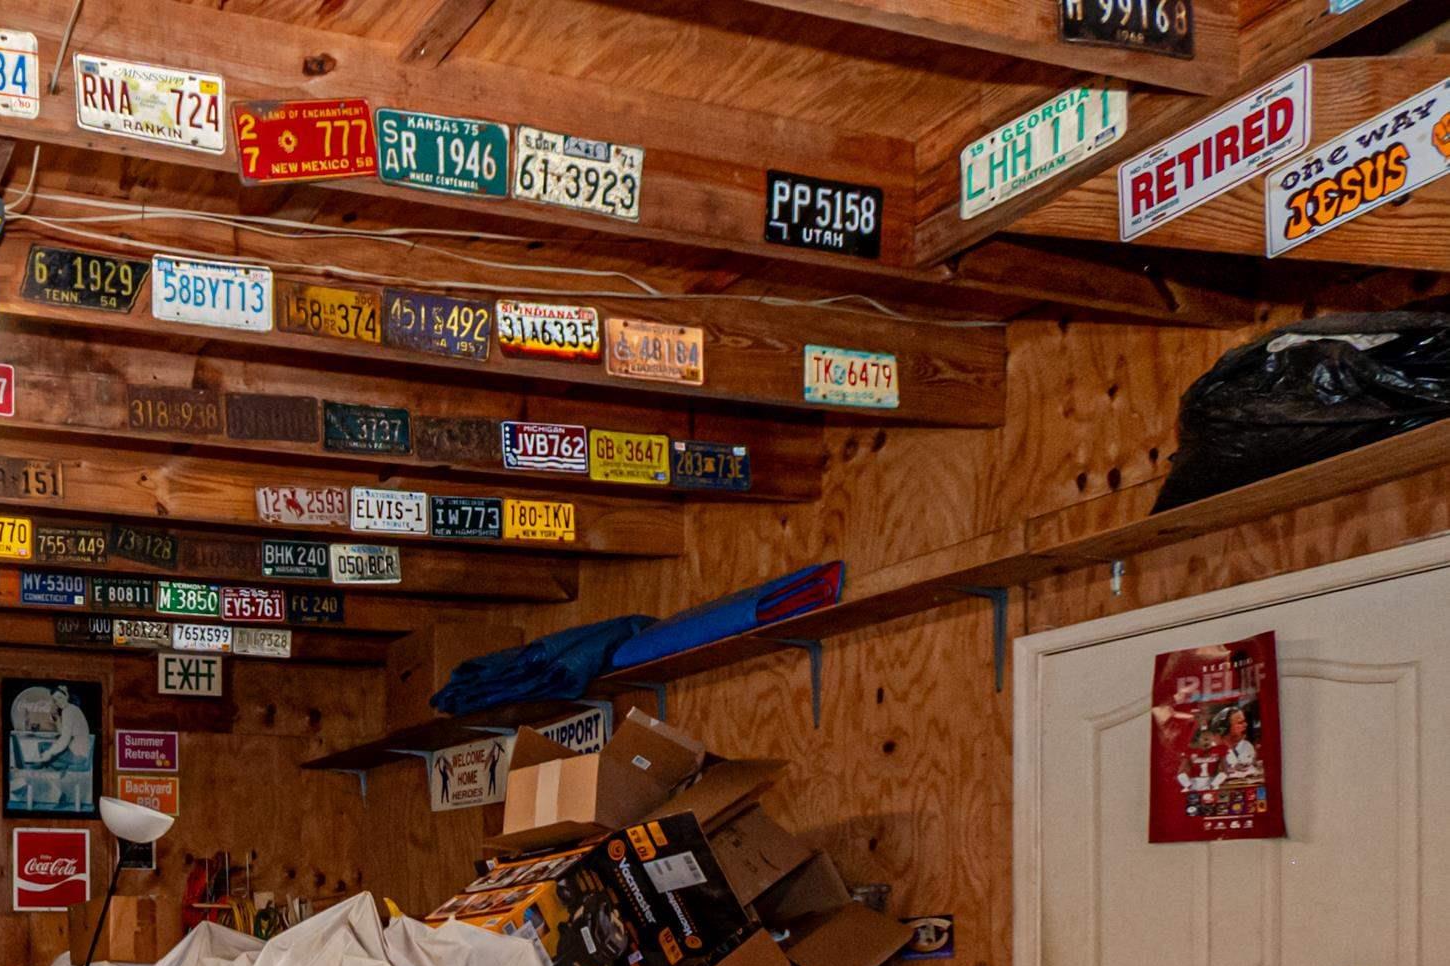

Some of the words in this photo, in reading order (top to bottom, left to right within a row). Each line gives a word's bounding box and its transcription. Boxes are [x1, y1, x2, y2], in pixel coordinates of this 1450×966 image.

[113, 67, 185, 86] MISSISSIPPI
[81, 72, 133, 116] RNA
[170, 88, 219, 132] 724
[302, 106, 365, 120] ENCHANTMENT
[1000, 85, 1092, 144] GEORGIA
[123, 119, 182, 140] RANKIN
[407, 117, 460, 135] KANSAS
[462, 121, 480, 136] 75
[315, 119, 369, 157] 777
[401, 130, 418, 171] R
[435, 137, 497, 181] 1946
[969, 142, 985, 158] 19
[1131, 96, 1294, 218] RETIRED
[1142, 151, 1169, 170] CLOCK
[270, 161, 299, 175] NEW
[301, 158, 349, 172] MEXICO
[620, 154, 635, 169] 71
[966, 131, 1033, 202] LHH
[435, 174, 480, 191] CENTENNIAL
[1010, 155, 1068, 190] CHATHAM
[1283, 141, 1412, 241] JESUS
[771, 179, 812, 224] PP
[815, 187, 877, 234] 5158
[801, 227, 844, 248] UTAH
[73, 258, 133, 297] 1929
[100, 296, 118, 309] 54
[163, 271, 265, 314] 58BYT13
[337, 304, 378, 340] 374
[445, 304, 489, 343] 492
[518, 306, 575, 321] INDIANA
[812, 356, 837, 385] TK
[847, 358, 893, 389] 6479
[522, 423, 566, 435] MICHIGAN
[511, 432, 586, 458] JVB762
[624, 439, 664, 464] 3647
[262, 490, 281, 512] 12
[307, 490, 346, 514] 2593
[356, 499, 423, 522] ELVIS-1
[434, 528, 452, 536] NEW
[455, 528, 499, 538] HAMPSHIRE
[37, 535, 66, 554] 755
[77, 536, 106, 555] 449
[264, 545, 295, 565] BHK
[296, 547, 327, 567] 240
[171, 582, 207, 591] VERMONT
[23, 593, 68, 602] CONNECTICUT
[177, 625, 230, 643] 765X599
[165, 658, 218, 692] EXIT
[124, 734, 165, 748] Summer
[124, 747, 160, 760] Retreat
[451, 749, 487, 769] WELCOME
[125, 779, 173, 796] Backyard
[457, 769, 479, 787] HOME
[452, 787, 485, 801] HEROES
[618, 856, 658, 925] Vacmaster
